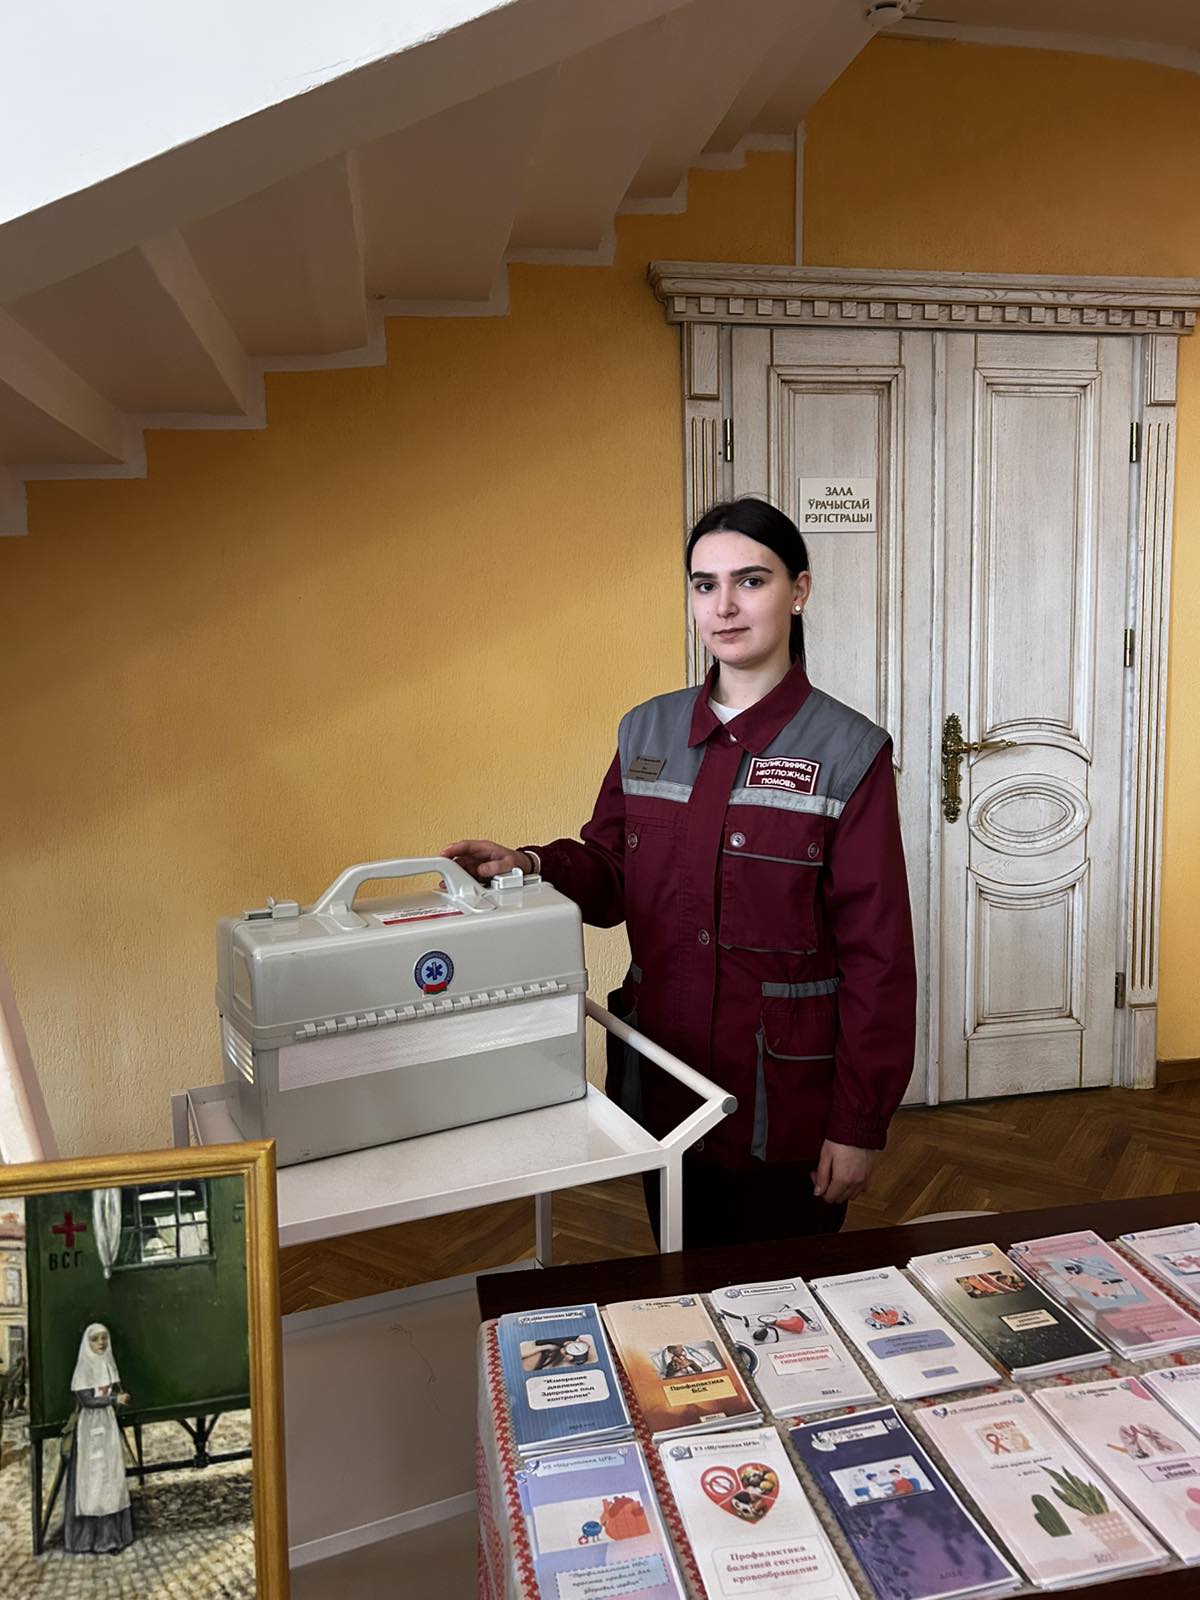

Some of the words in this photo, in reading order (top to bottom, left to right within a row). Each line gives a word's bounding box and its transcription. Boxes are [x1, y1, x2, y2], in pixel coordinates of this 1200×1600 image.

[825, 486, 853, 496] ЗАЛА
[808, 498, 870, 510] ЎРАЧЫСТАЙ
[805, 513, 872, 523] РЭГІСТРАЦЫІ
[755, 760, 813, 772] ПОЛИКЛИНИКА
[755, 769, 811, 783] НЕОТЛОЖНАЯ
[761, 777, 796, 789] ПОМОЩЬ
[49, 1250, 83, 1271] ВСГ
[670, 1378, 724, 1391] Профилактика
[541, 1388, 578, 1397] Здоровье
[730, 1544, 806, 1562] Профилактика
[726, 1558, 772, 1573] болезней
[773, 1553, 816, 1568] системы
[732, 1563, 819, 1584] кровообращения
